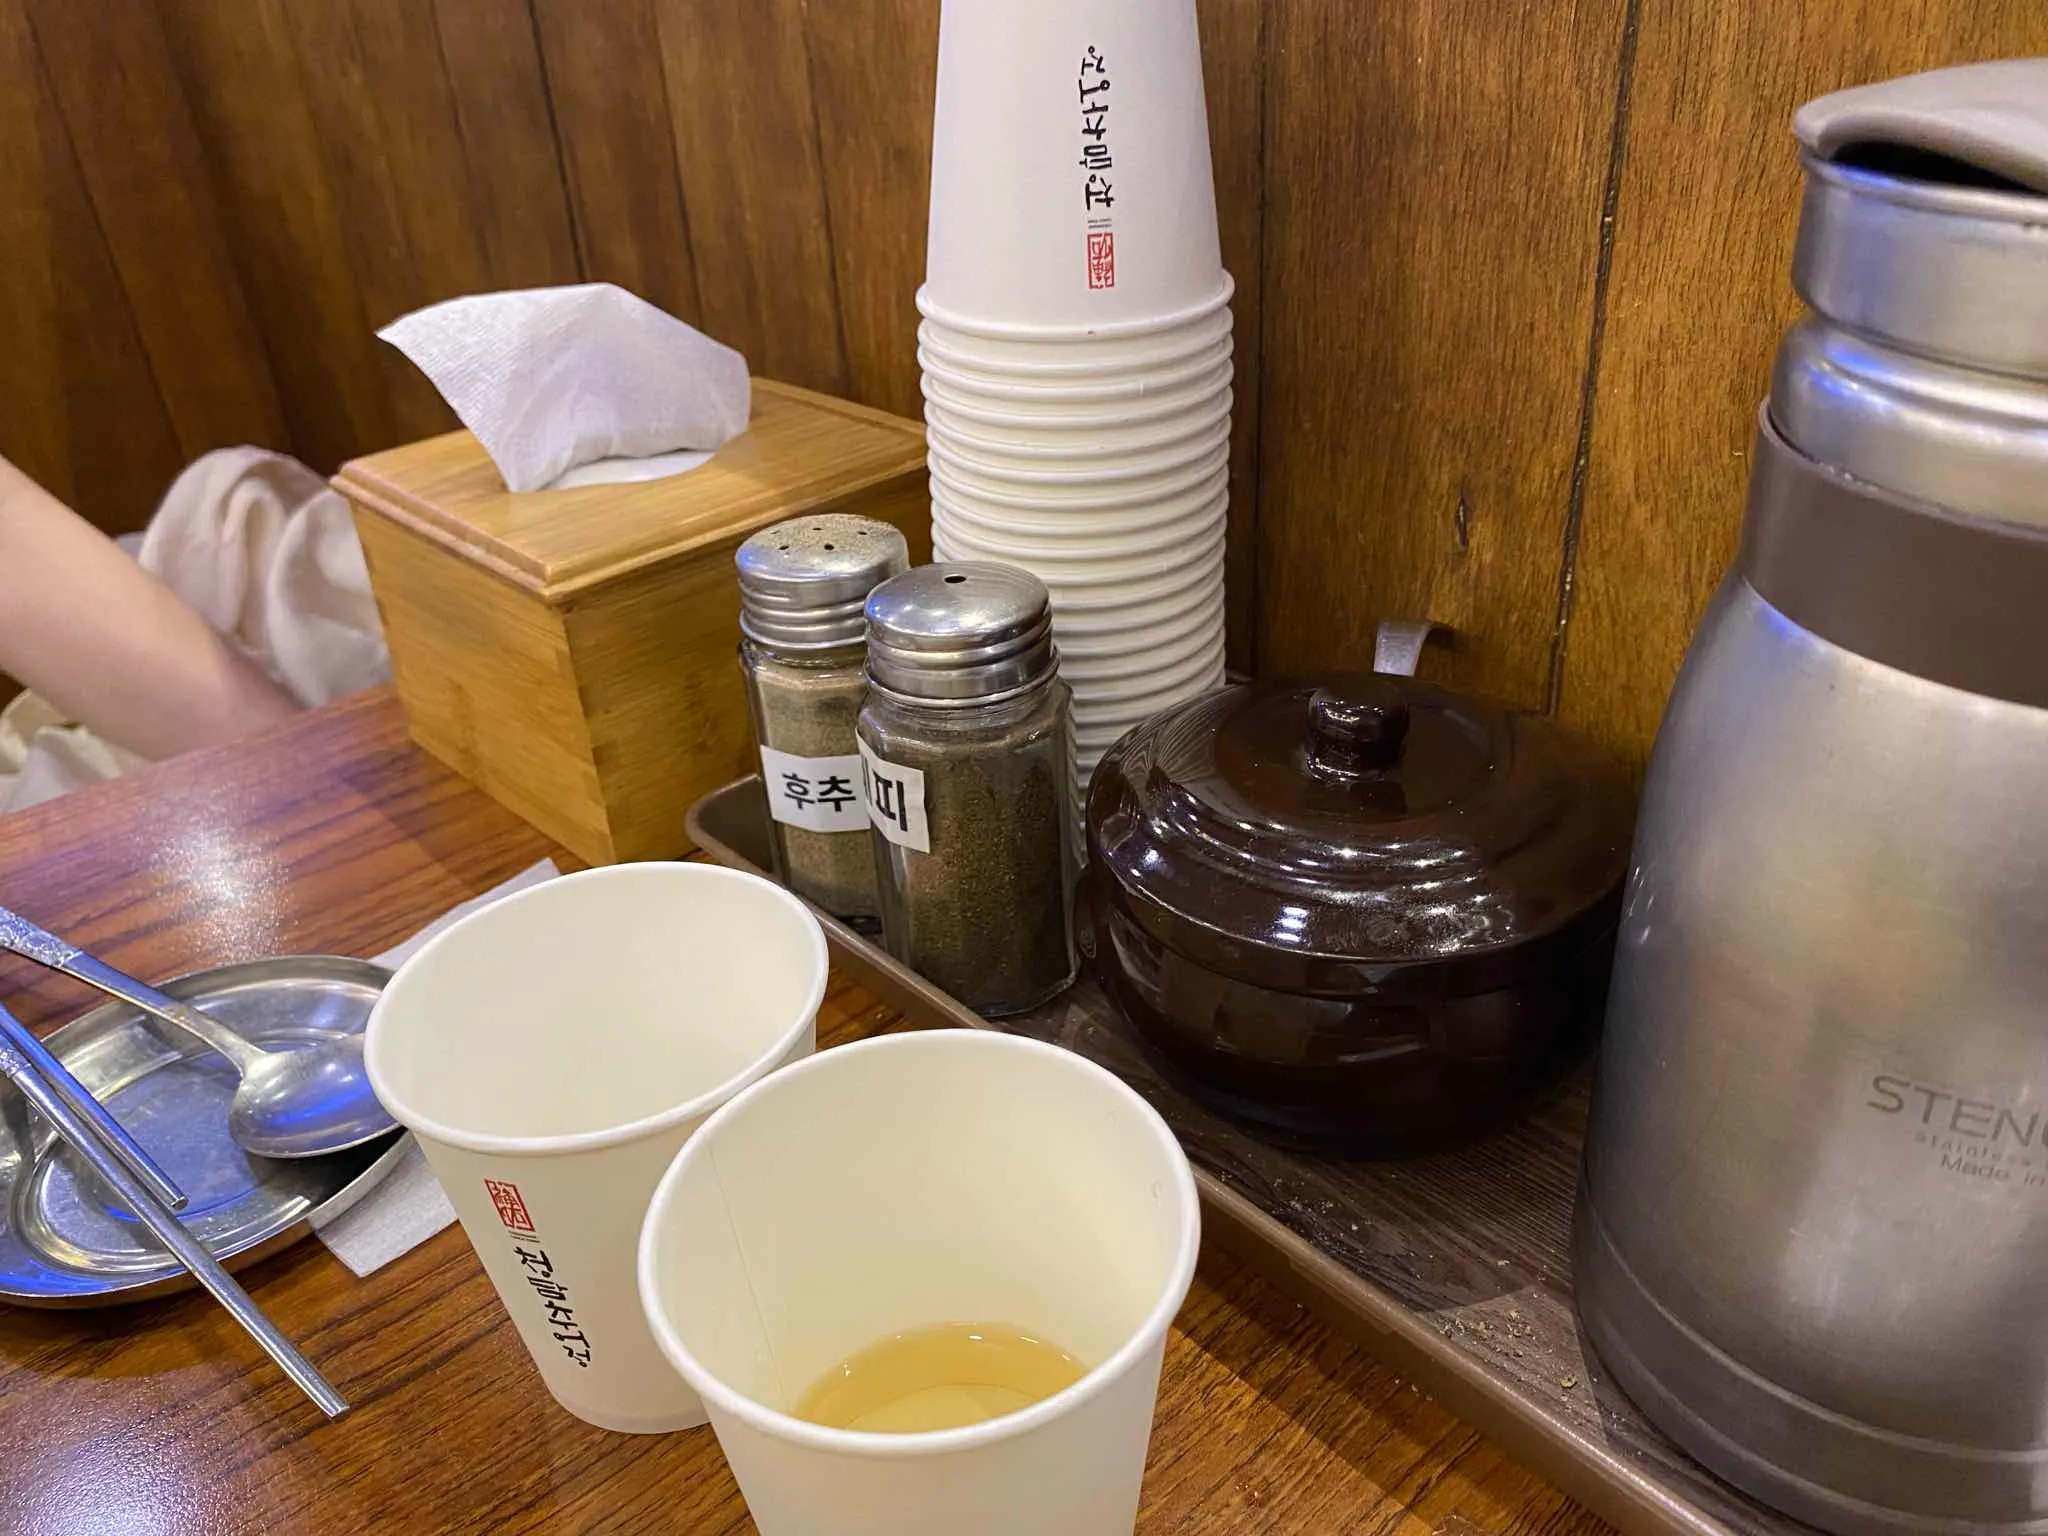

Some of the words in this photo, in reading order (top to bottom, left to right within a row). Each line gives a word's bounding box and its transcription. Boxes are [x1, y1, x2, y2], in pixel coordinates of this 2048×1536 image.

[1079, 46, 1114, 210] 청담추어정
[782, 772, 856, 812] 후추
[513, 1247, 591, 1368] 청담추어정
